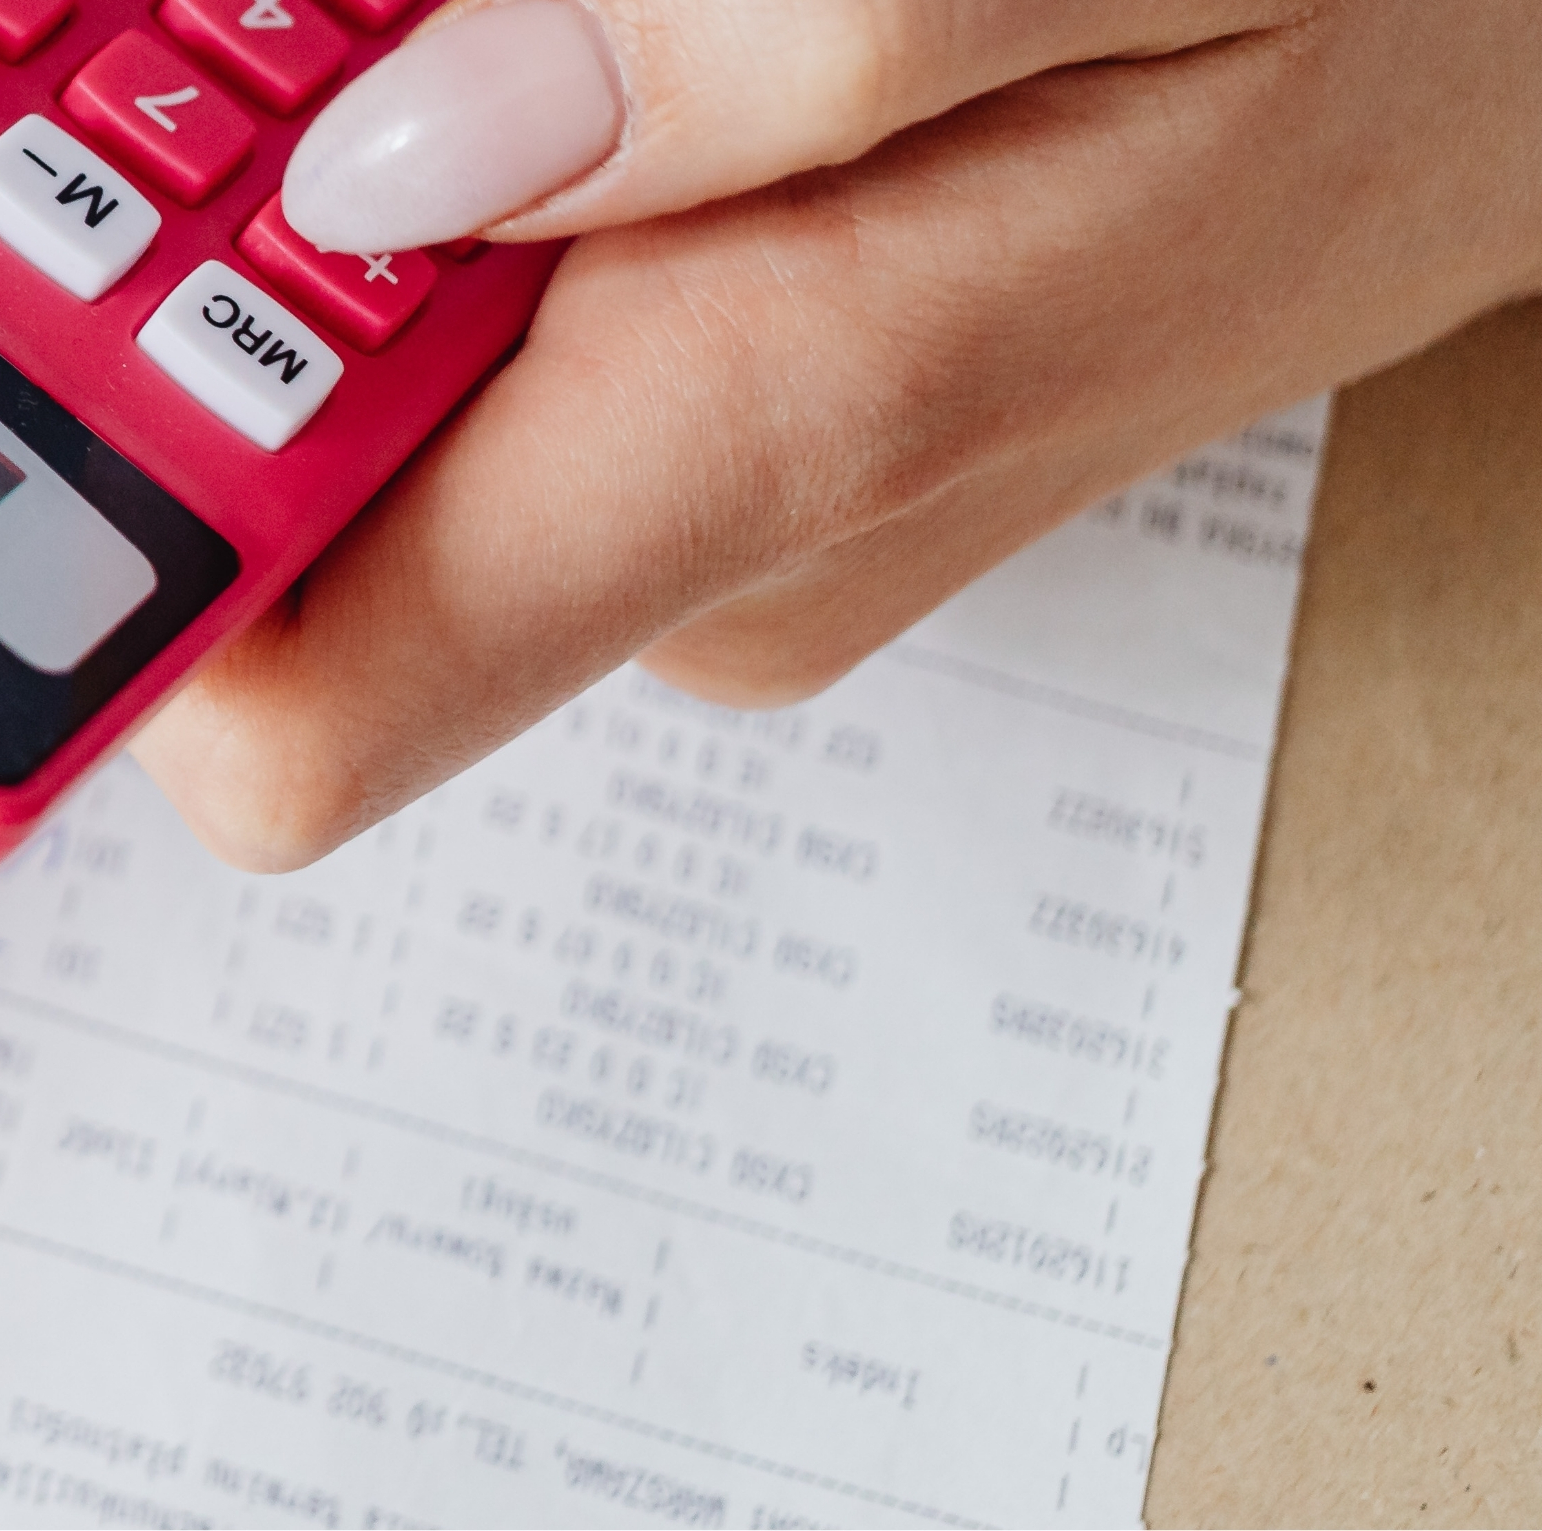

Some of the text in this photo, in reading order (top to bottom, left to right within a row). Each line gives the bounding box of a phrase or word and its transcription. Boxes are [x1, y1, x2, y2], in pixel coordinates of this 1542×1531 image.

[133, 85, 200, 133] 7
[202, 294, 308, 384] MRC
[795, 1338, 923, 1411] Indeks
[0, 1394, 193, 1485] płatności
[1099, 1419, 1153, 1475] Lp
